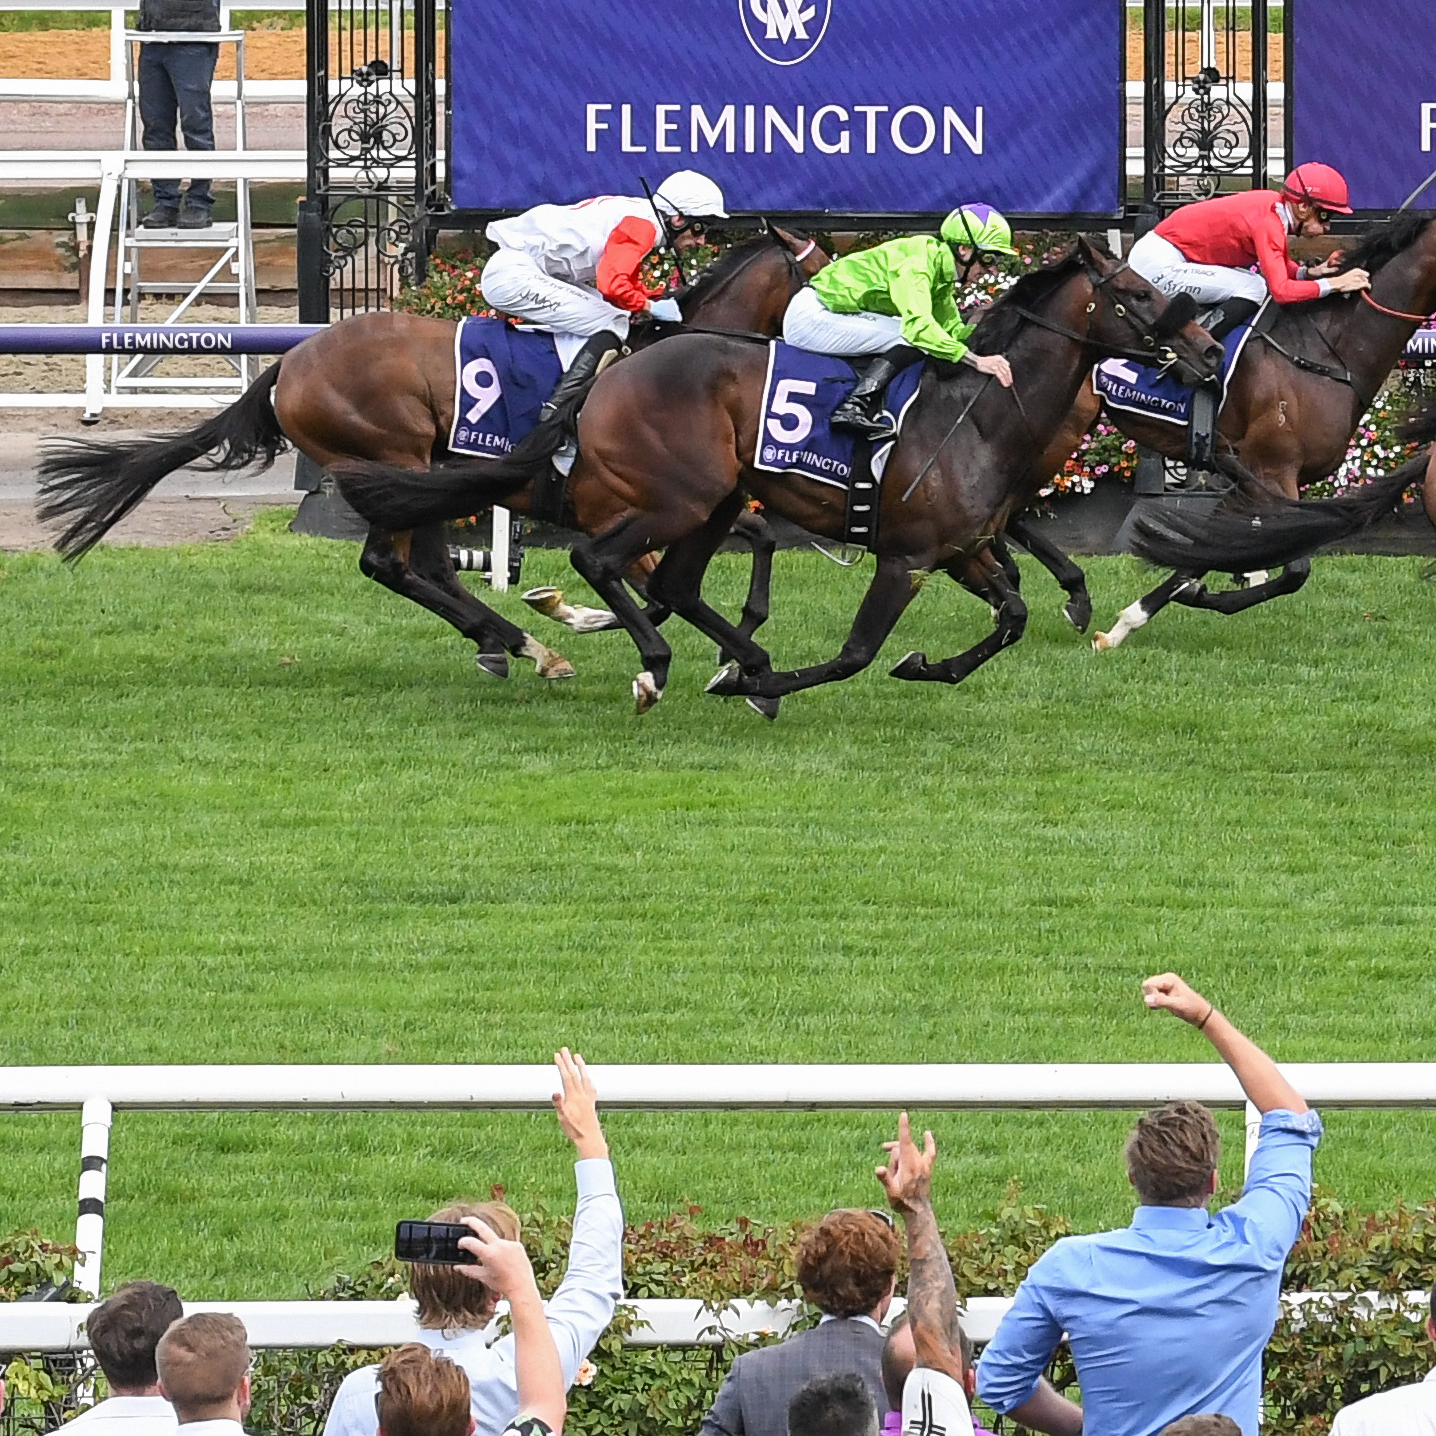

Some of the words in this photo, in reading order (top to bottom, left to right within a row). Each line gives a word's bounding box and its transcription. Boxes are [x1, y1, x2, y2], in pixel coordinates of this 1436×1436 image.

[585, 103, 984, 156] FLEMINGTON
[101, 332, 232, 349] FLEMINGTON
[462, 357, 502, 425] 9
[766, 378, 817, 443] 5
